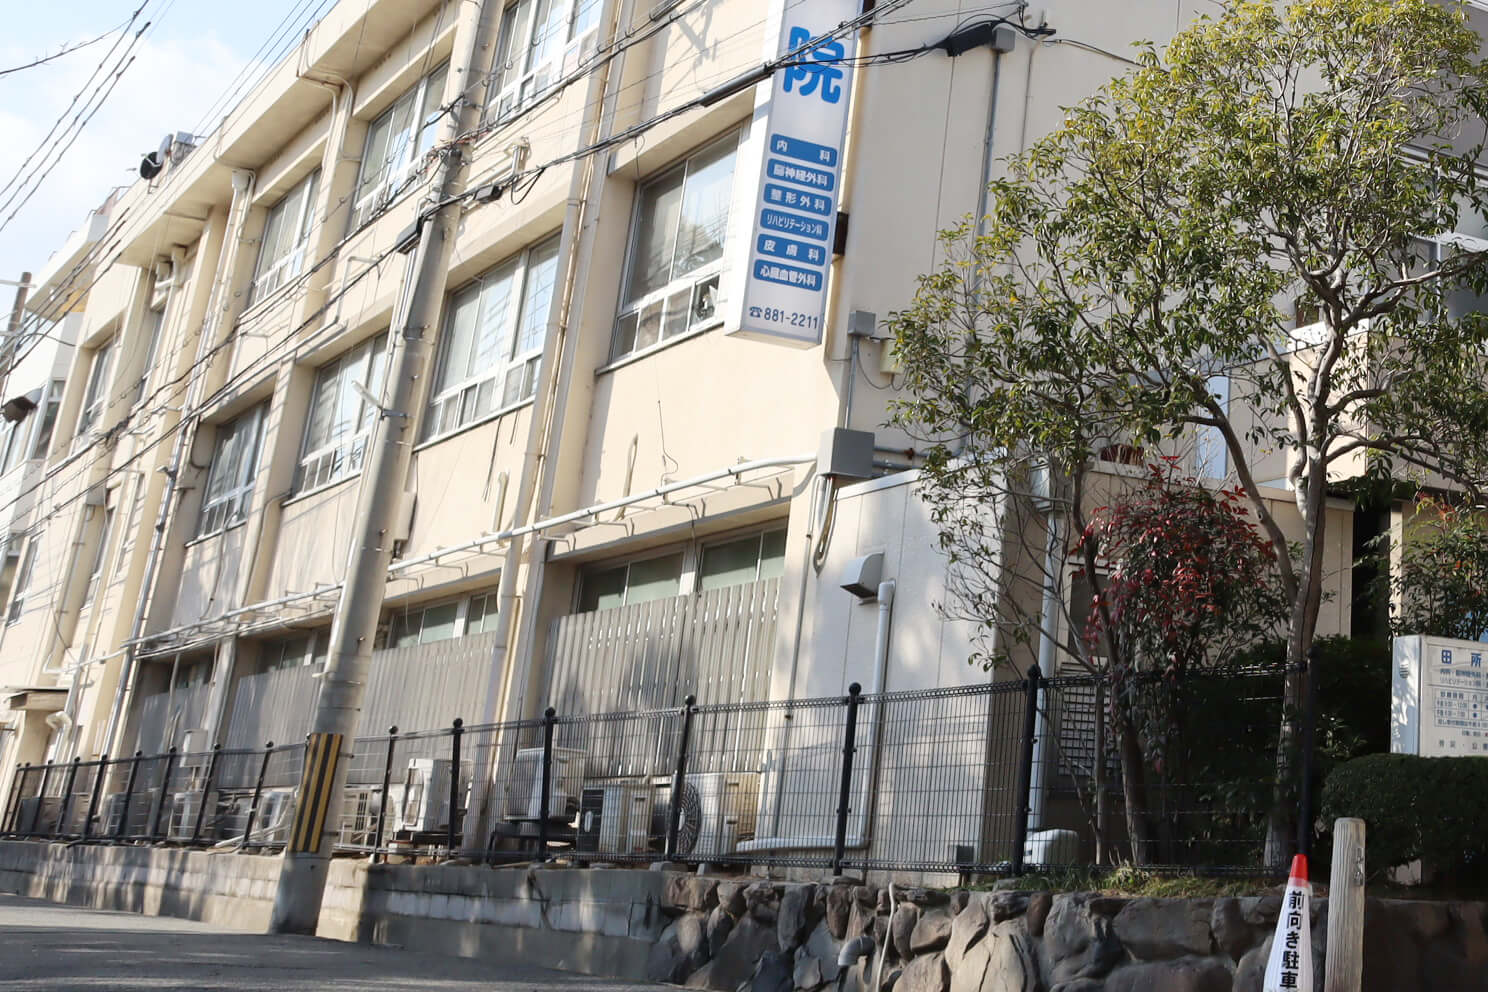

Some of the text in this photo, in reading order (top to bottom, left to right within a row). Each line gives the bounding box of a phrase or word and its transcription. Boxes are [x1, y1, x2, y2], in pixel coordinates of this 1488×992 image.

[776, 139, 831, 163] 内科
[770, 188, 825, 211] 整形外科
[767, 214, 822, 236] リハビリテーション科
[763, 238, 820, 262] 皮膚科
[759, 265, 817, 287] 心臓血管外科
[1279, 890, 1305, 990] 前向き駐車
